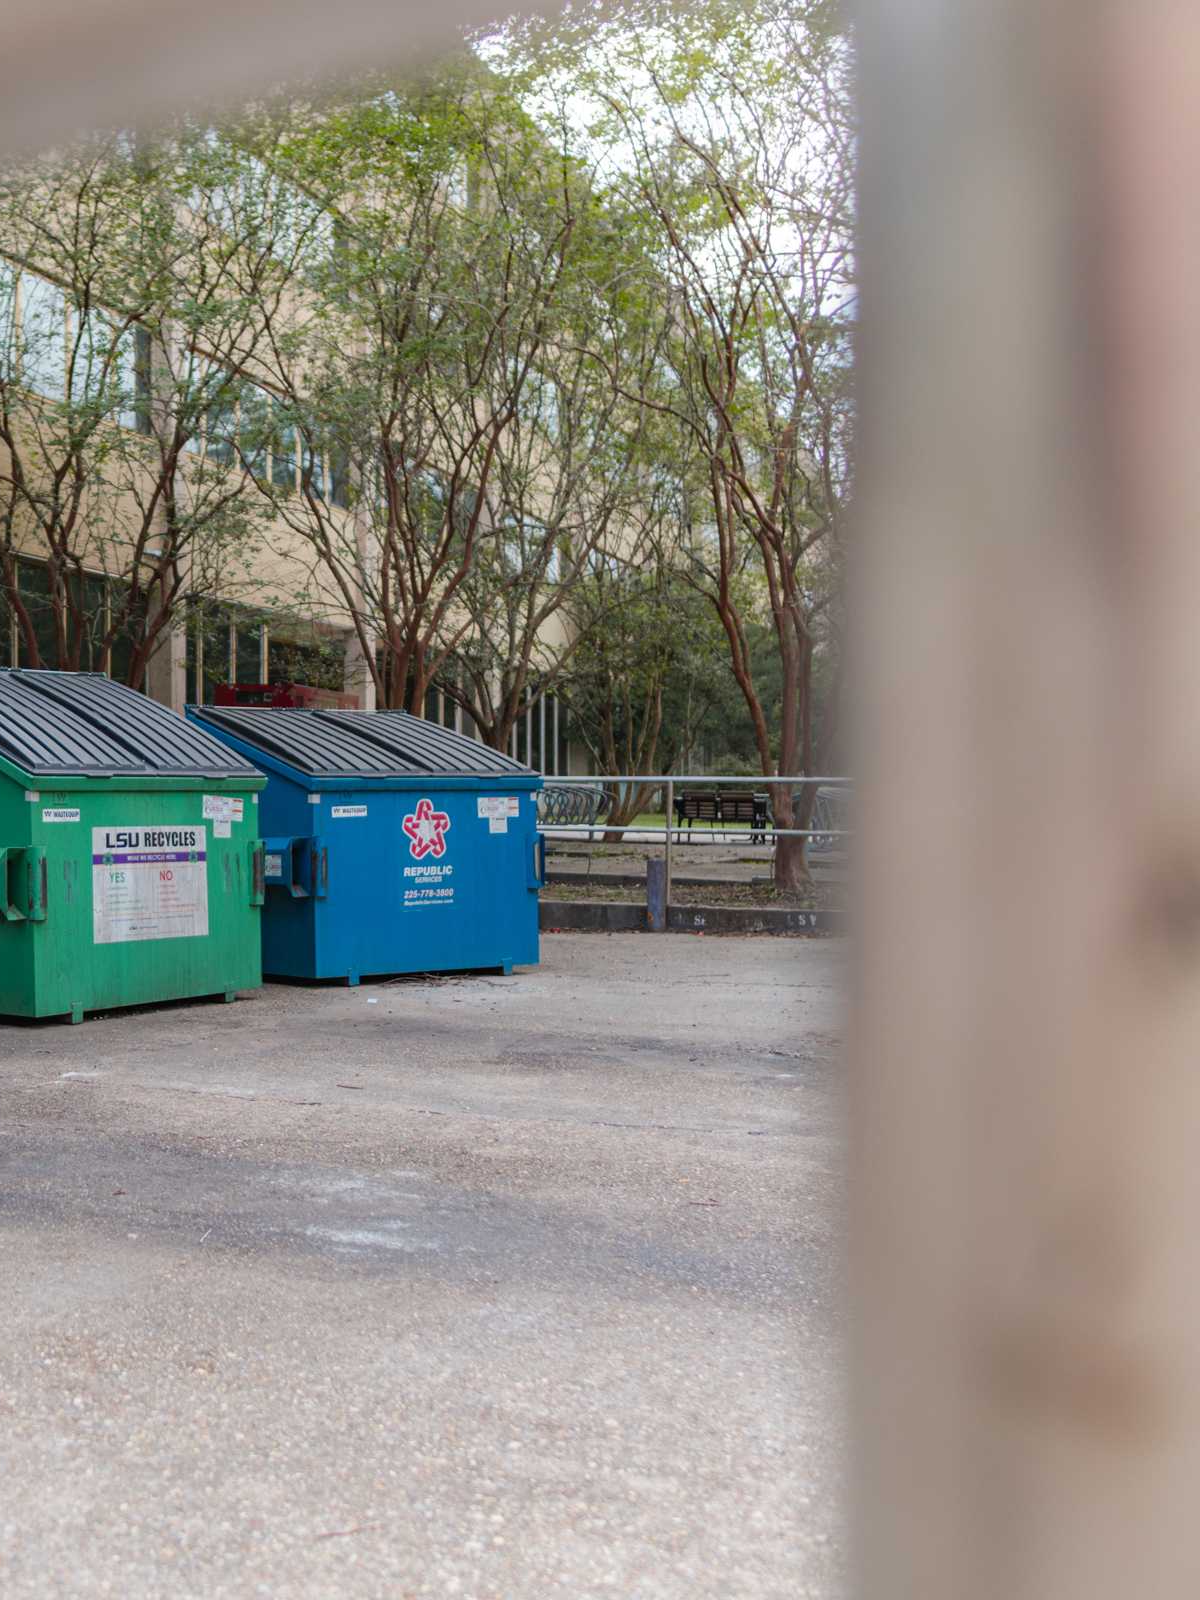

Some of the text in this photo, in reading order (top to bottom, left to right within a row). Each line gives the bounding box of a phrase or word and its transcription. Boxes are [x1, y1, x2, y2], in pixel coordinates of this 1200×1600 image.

[105, 831, 196, 849] LSU RECYCLES
[159, 869, 174, 881] NO
[403, 865, 453, 877] REPUBLIC
[108, 871, 127, 884] YES
